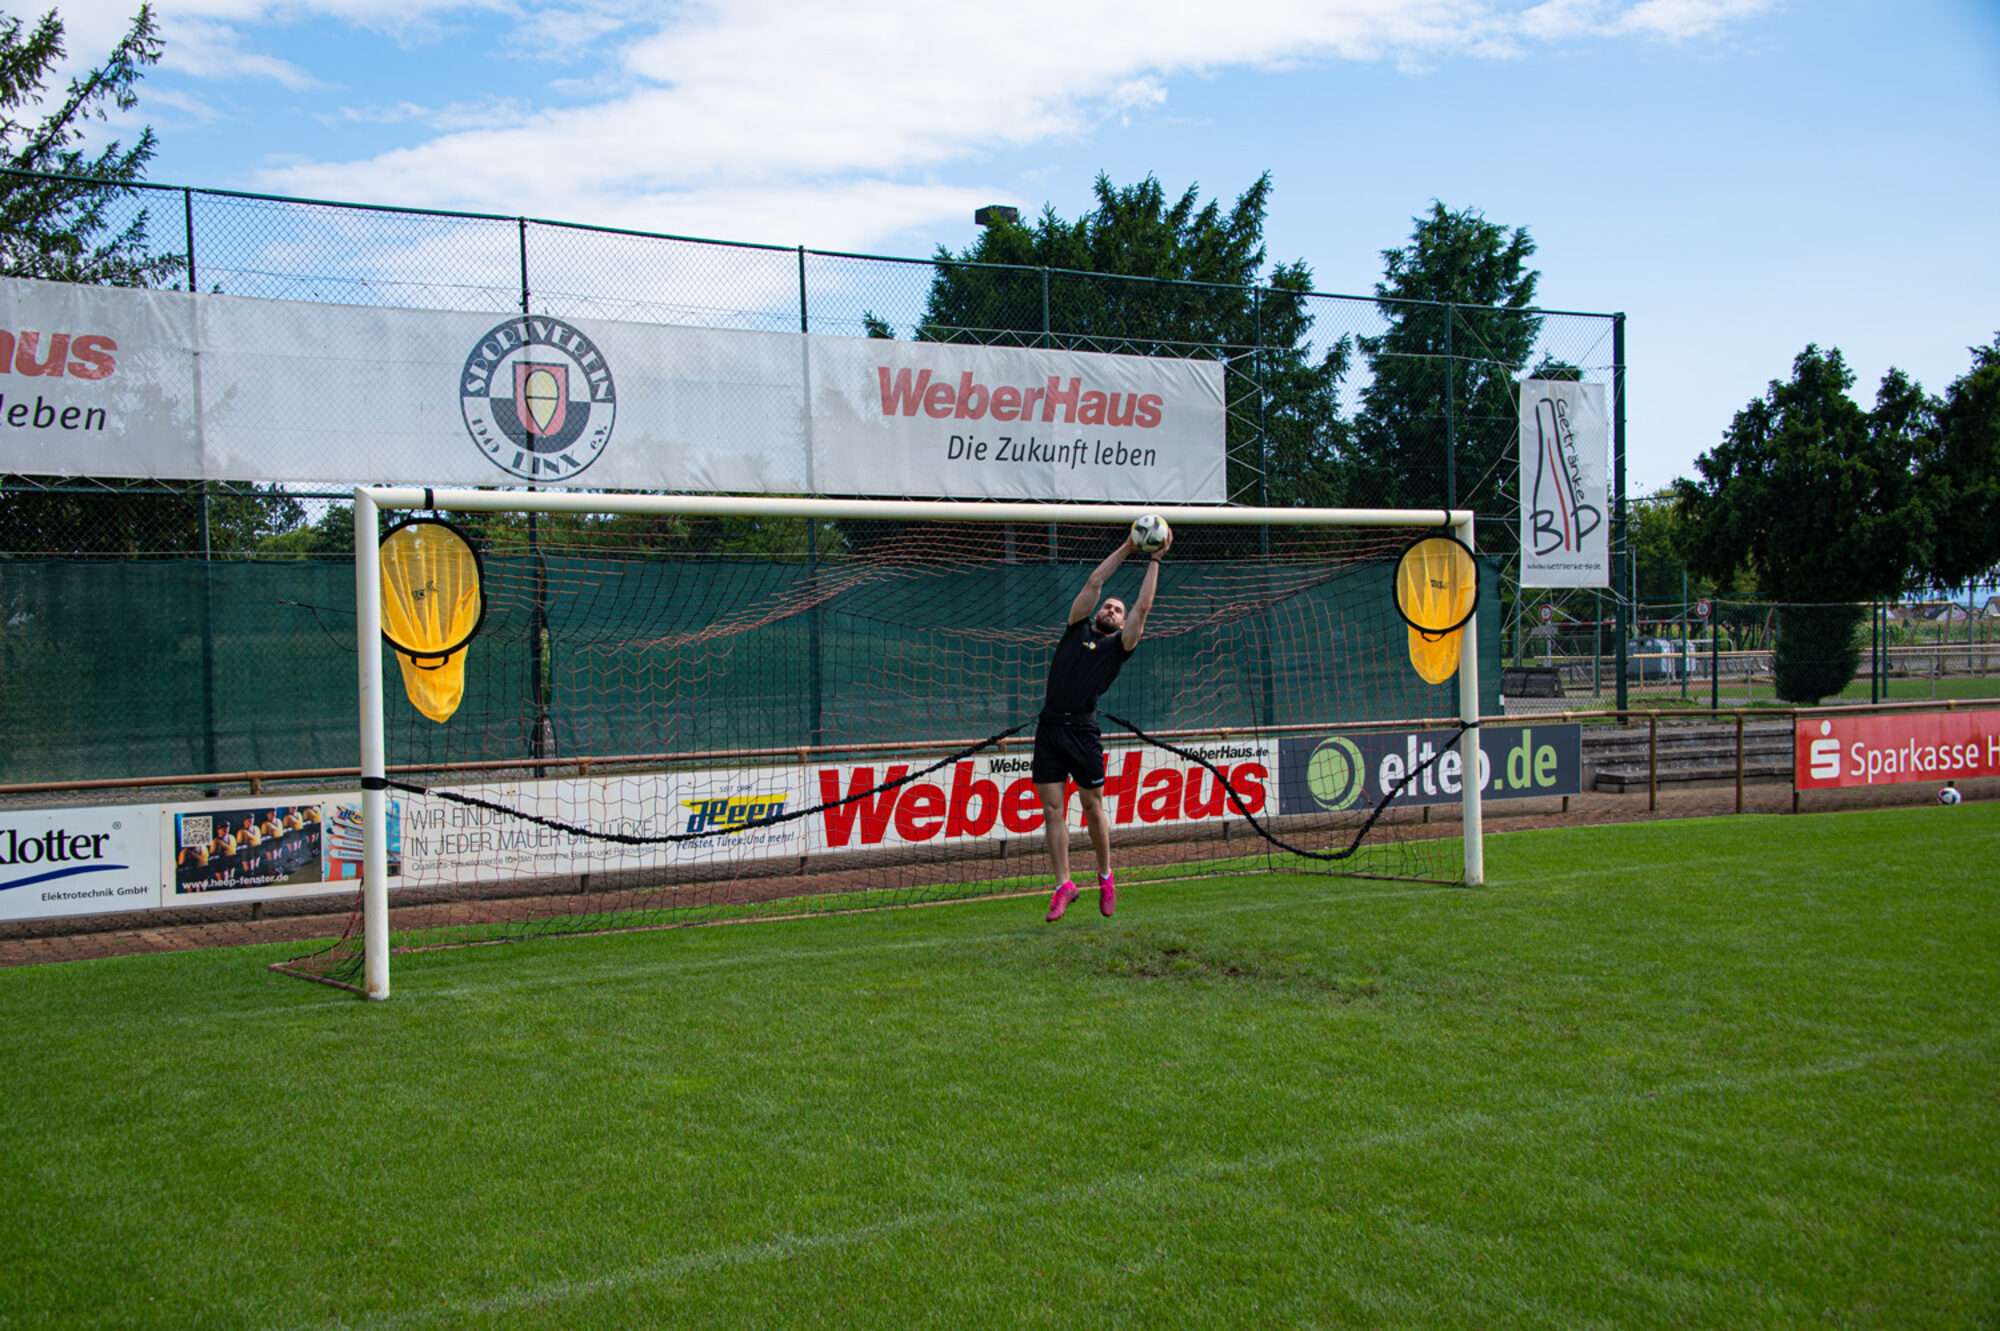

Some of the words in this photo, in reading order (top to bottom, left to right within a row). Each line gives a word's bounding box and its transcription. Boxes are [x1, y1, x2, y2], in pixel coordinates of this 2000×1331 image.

[466, 320, 613, 401] SPORTVEREIN
[878, 366, 1164, 428] WeberHaus
[511, 450, 582, 475] LINX
[947, 435, 988, 461] Die
[995, 436, 1088, 469] Zukunft
[1094, 440, 1157, 467] leben
[1556, 399, 1585, 503] Getränke
[1850, 738, 1979, 784] Sparkasse
[410, 808, 445, 830] WIR
[411, 836, 428, 857] IN
[435, 832, 492, 855] JEDER
[41, 887, 114, 902] Elektrotechnik
[117, 886, 148, 896] GmbH
